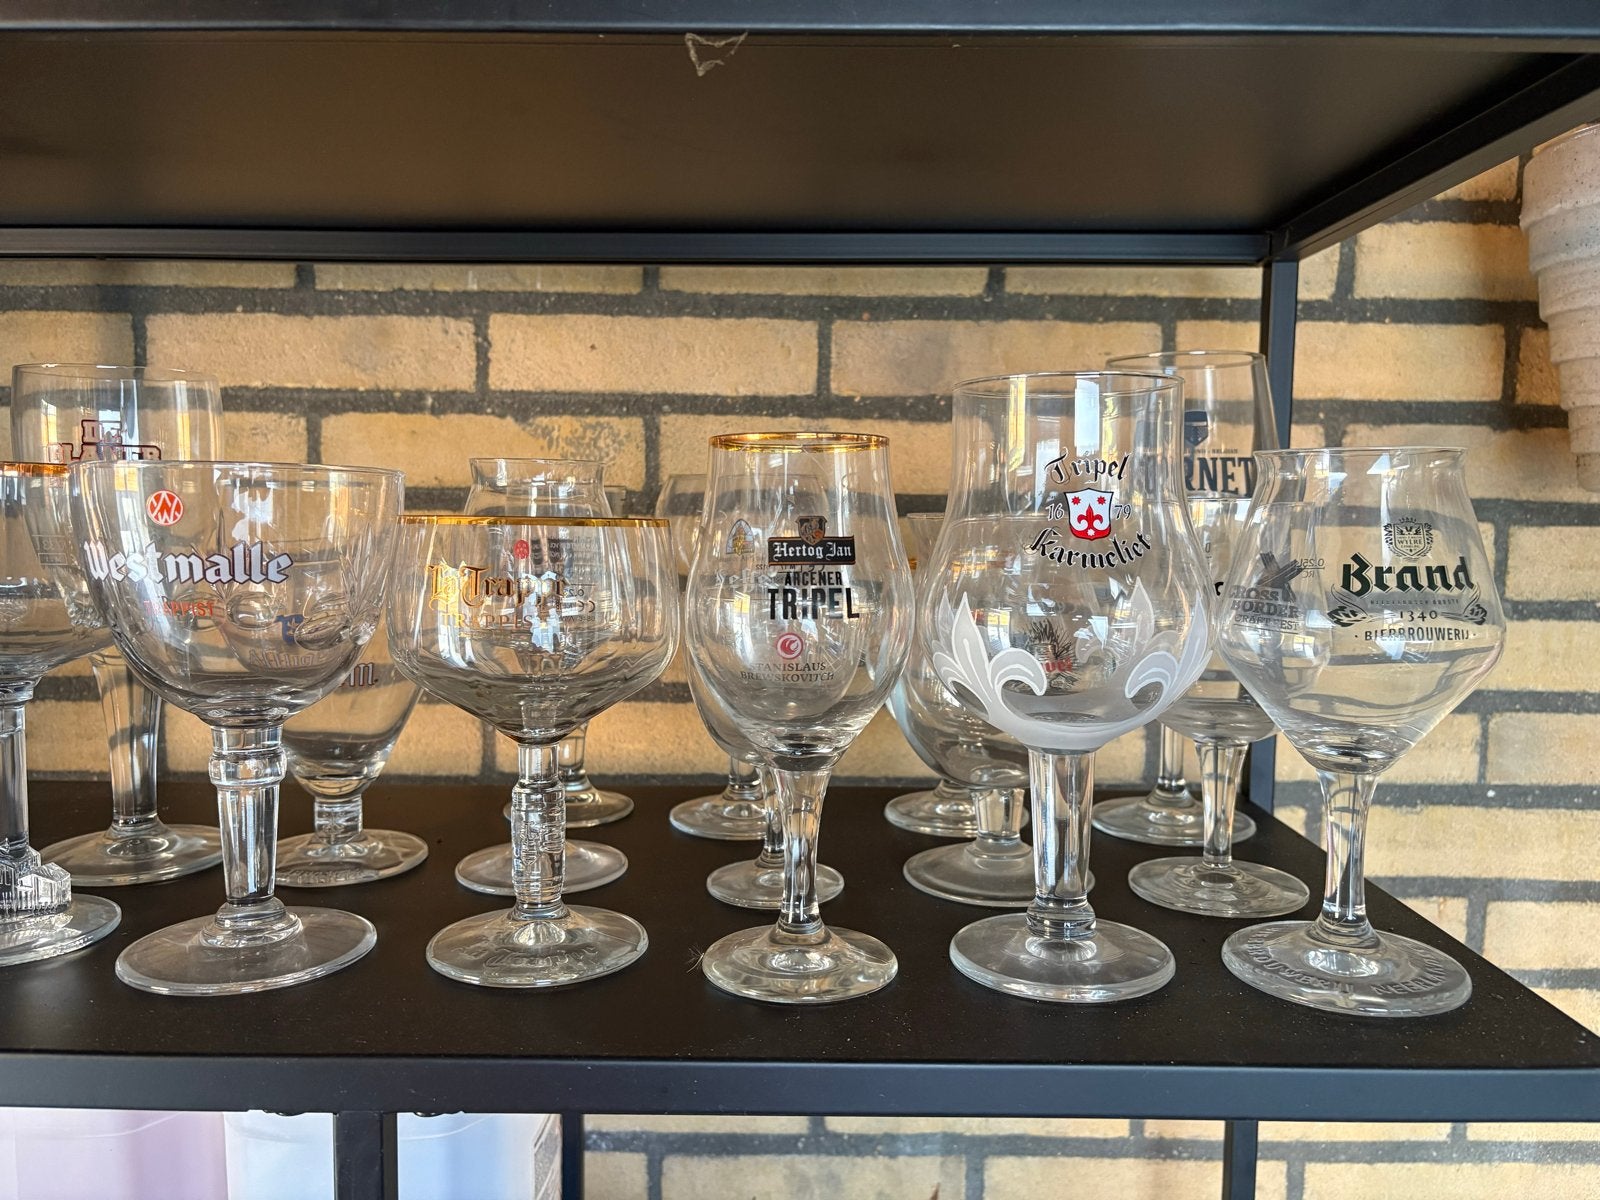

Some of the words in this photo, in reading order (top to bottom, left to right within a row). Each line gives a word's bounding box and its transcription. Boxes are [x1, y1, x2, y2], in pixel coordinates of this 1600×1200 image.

[1044, 446, 1132, 485] Tripel
[1045, 502, 1065, 521] 16
[1113, 504, 1132, 520] 79
[772, 542, 824, 562] Hertog
[827, 542, 853, 561] Jan
[1023, 526, 1152, 569] Karmeliet
[84, 541, 294, 585] Westmalle
[784, 571, 844, 586] ARCENER
[1340, 551, 1475, 599] Brand
[768, 588, 860, 620] TRIPEL
[1400, 610, 1438, 622] 1340
[1364, 626, 1469, 641] BIERBROUWERIJ
[740, 670, 834, 682] BREWSKOVITCH
[749, 662, 826, 672] STANISLAUS
